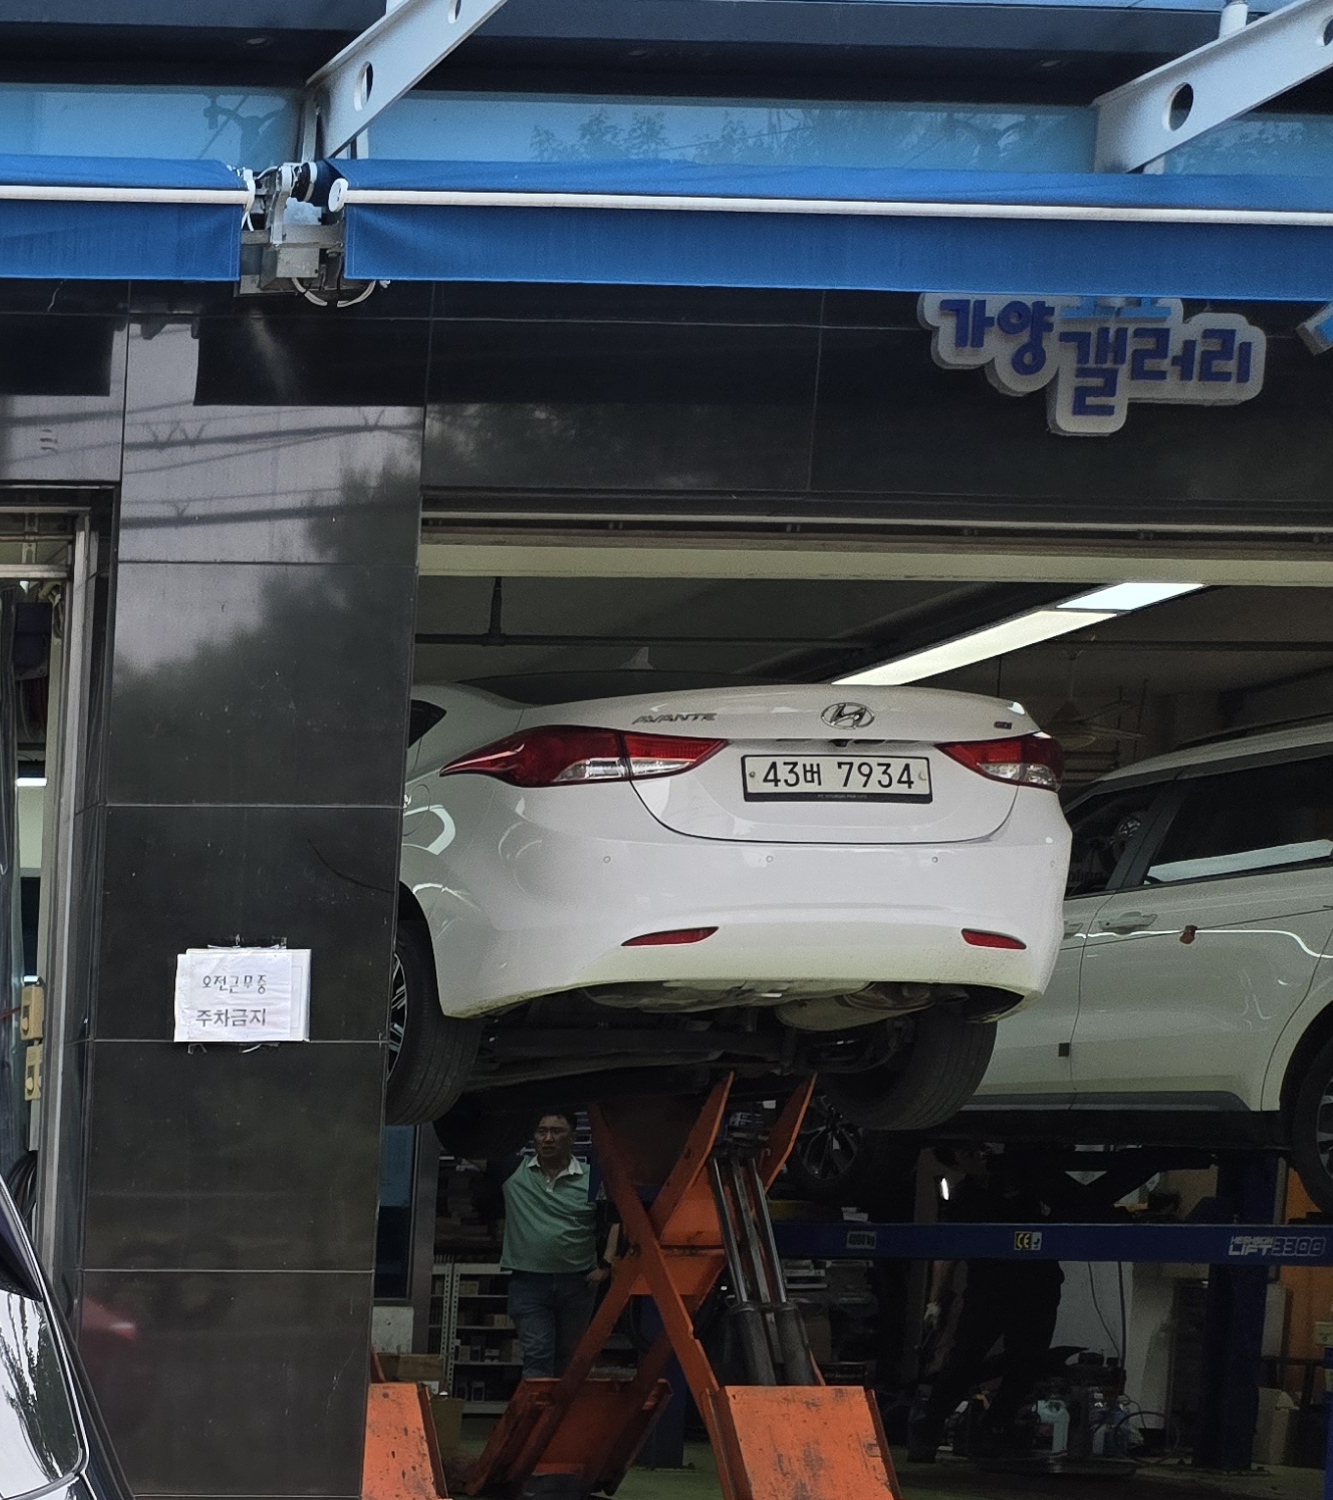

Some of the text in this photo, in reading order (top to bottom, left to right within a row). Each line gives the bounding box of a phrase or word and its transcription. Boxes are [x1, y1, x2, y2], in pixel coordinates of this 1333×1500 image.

[939, 298, 1252, 416] 가양 갤러리
[631, 713, 717, 725] AVANTE
[762, 761, 915, 790] 43버 7934
[195, 1008, 267, 1028] 주차금지
[1228, 1244, 1272, 1256] LIFT
